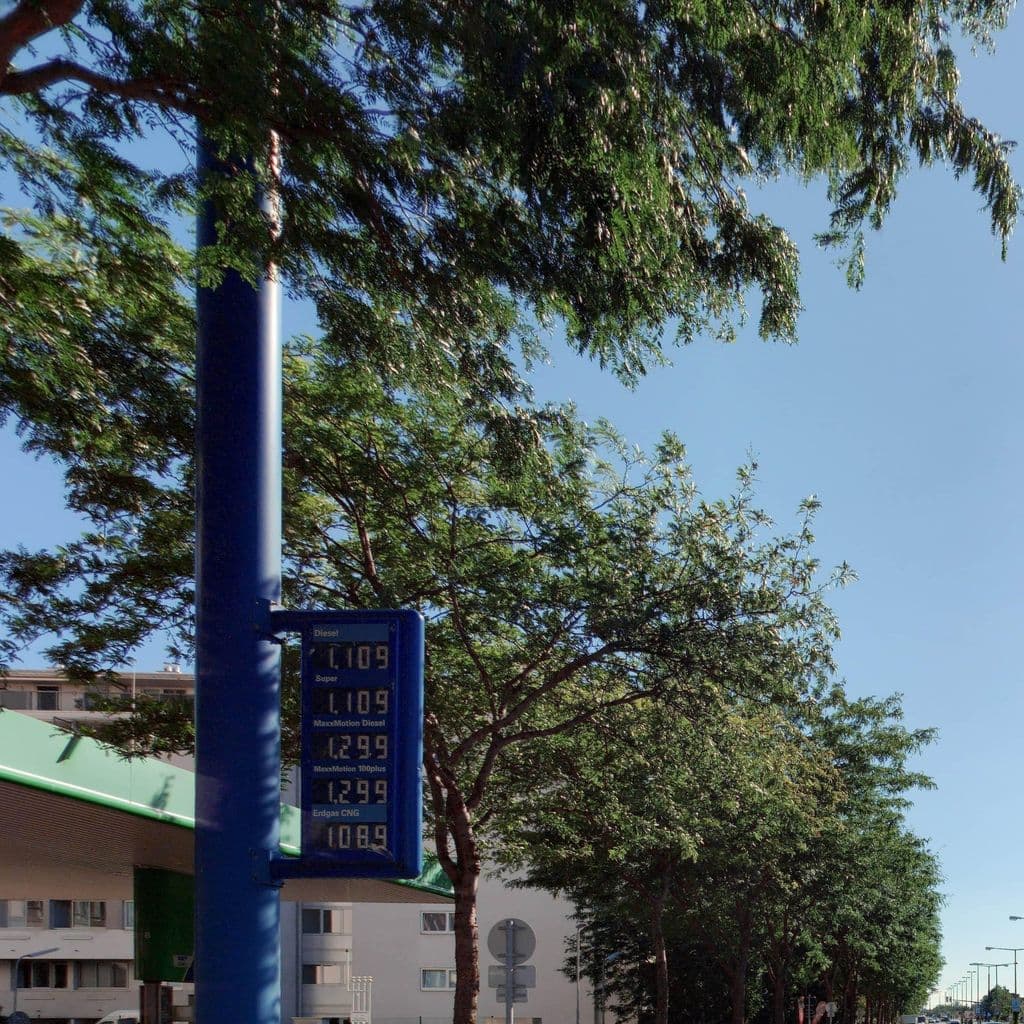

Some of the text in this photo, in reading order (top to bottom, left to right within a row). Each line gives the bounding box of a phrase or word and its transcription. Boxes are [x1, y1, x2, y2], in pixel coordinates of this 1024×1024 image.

[314, 629, 339, 637] Diesel
[315, 675, 338, 683] Super
[362, 719, 386, 727] Diesel
[358, 764, 386, 774] 100plus
[313, 808, 360, 819] Erdgas CNG
